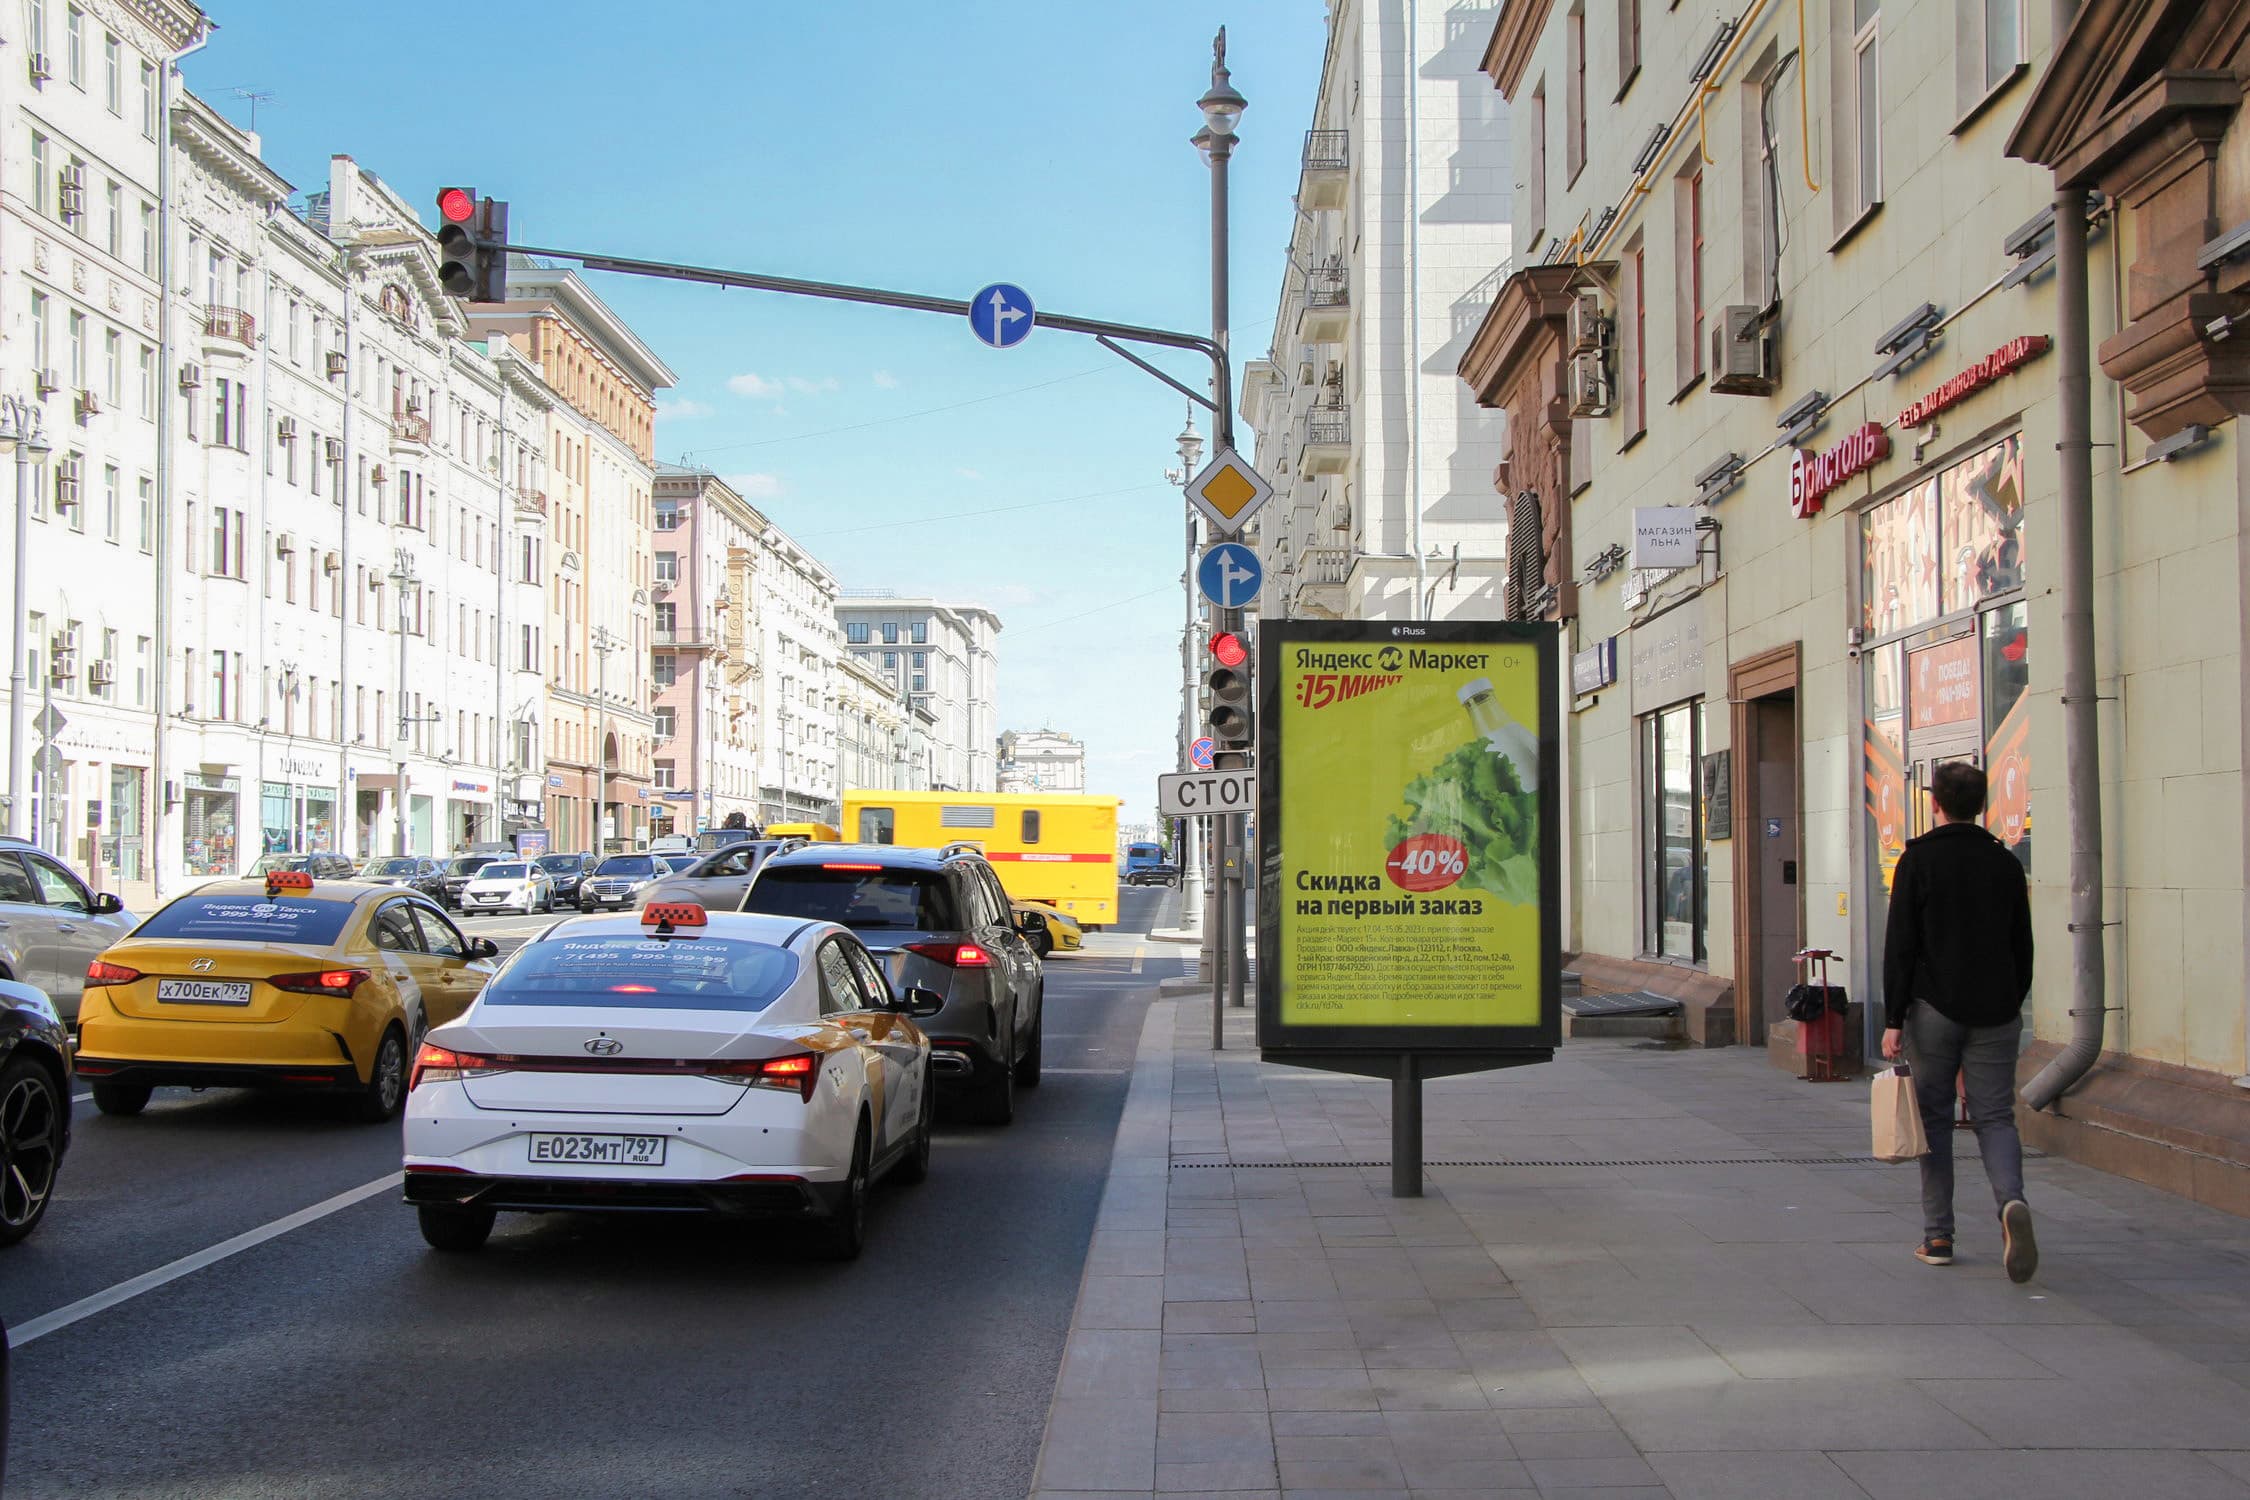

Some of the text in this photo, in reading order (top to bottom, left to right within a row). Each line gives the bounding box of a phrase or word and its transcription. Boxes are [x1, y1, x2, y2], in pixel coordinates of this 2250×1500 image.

[1921, 365, 1977, 416] МАГАЗИНОВ
[1638, 527, 1692, 536] МАГАЗИН
[1650, 539, 1680, 547] ЛЬНА
[1402, 626, 1426, 636] Russ
[1296, 649, 1521, 672] Яндекс Маркет 0+
[1296, 871, 1381, 894] Скидка
[280, 906, 317, 914] Такси
[1296, 895, 1483, 919] на первый заказ
[219, 911, 298, 919] 999-99-99
[1336, 944, 1354, 954] ООО
[1296, 963, 1318, 972] ОГРН
[224, 984, 247, 996] 797
[626, 1138, 659, 1155] 797
